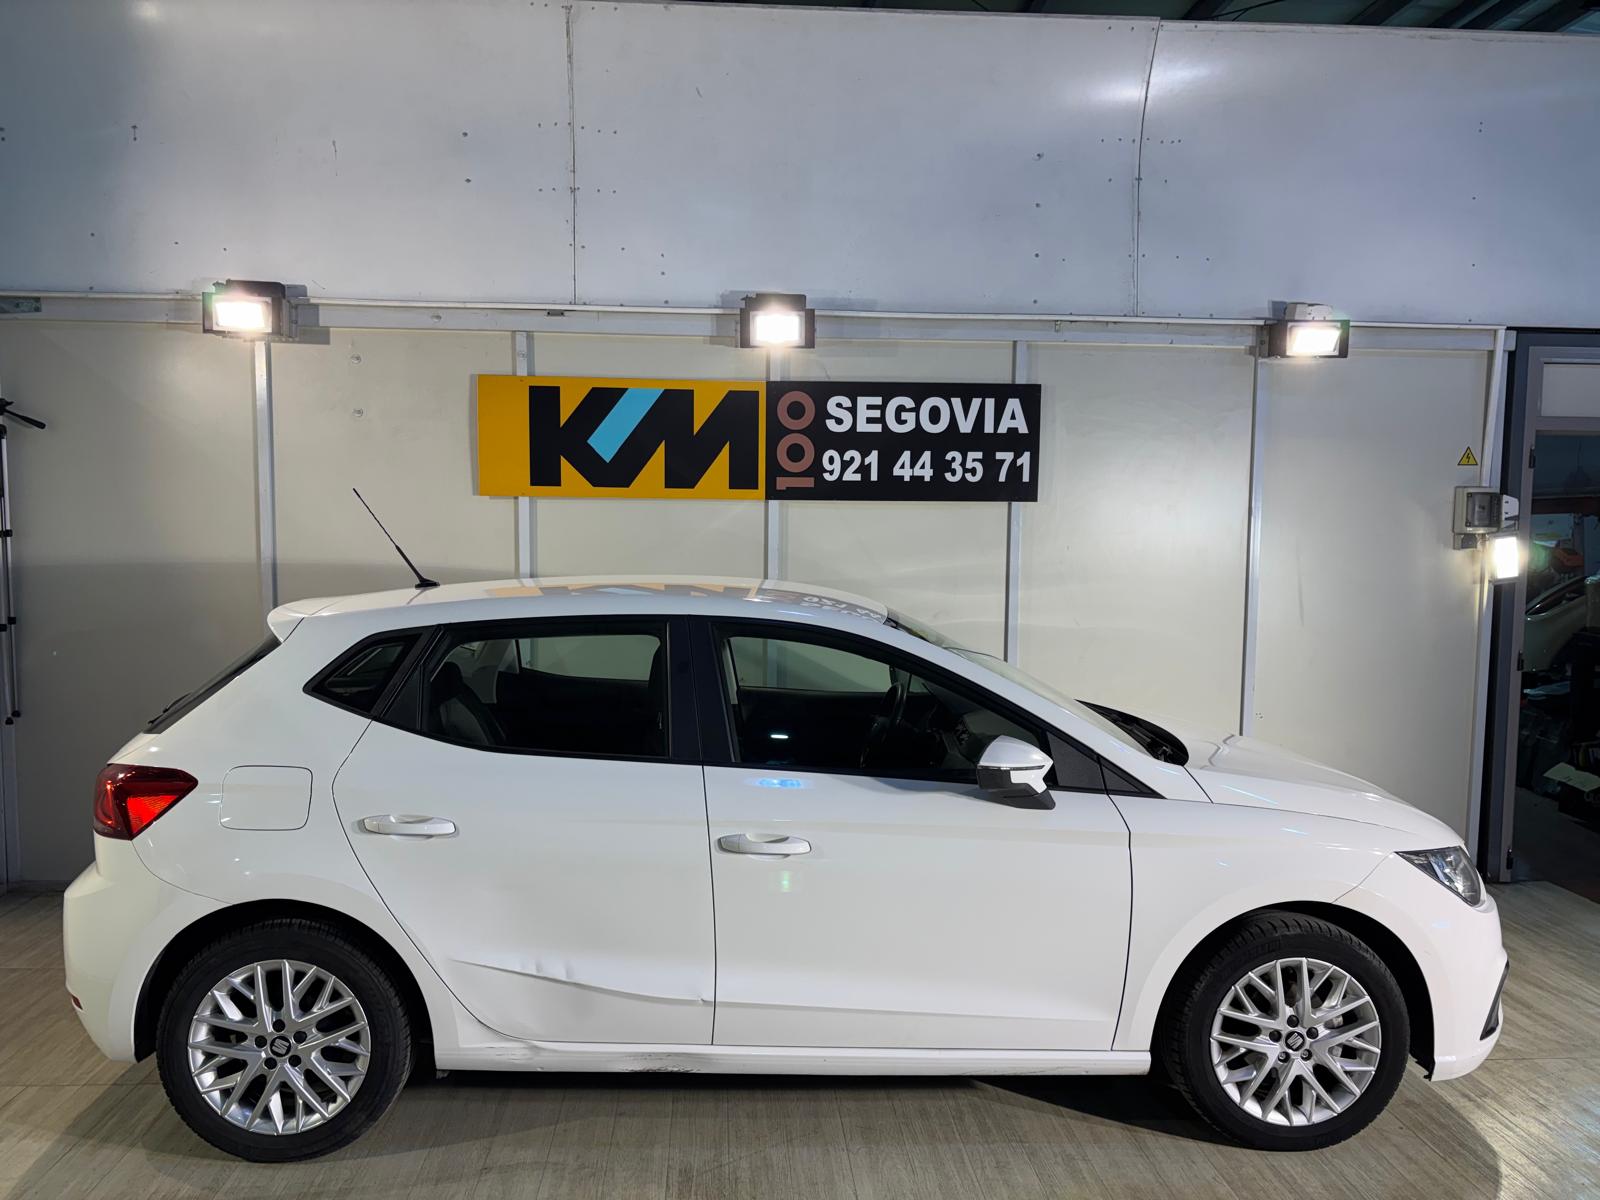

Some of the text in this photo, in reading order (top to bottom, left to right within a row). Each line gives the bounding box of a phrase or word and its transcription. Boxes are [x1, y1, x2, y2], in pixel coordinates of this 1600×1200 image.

[529, 385, 759, 489] KM
[776, 390, 816, 490] 100
[825, 395, 1029, 434] SEGOVIA
[822, 449, 1031, 483] 921 44 35 71
